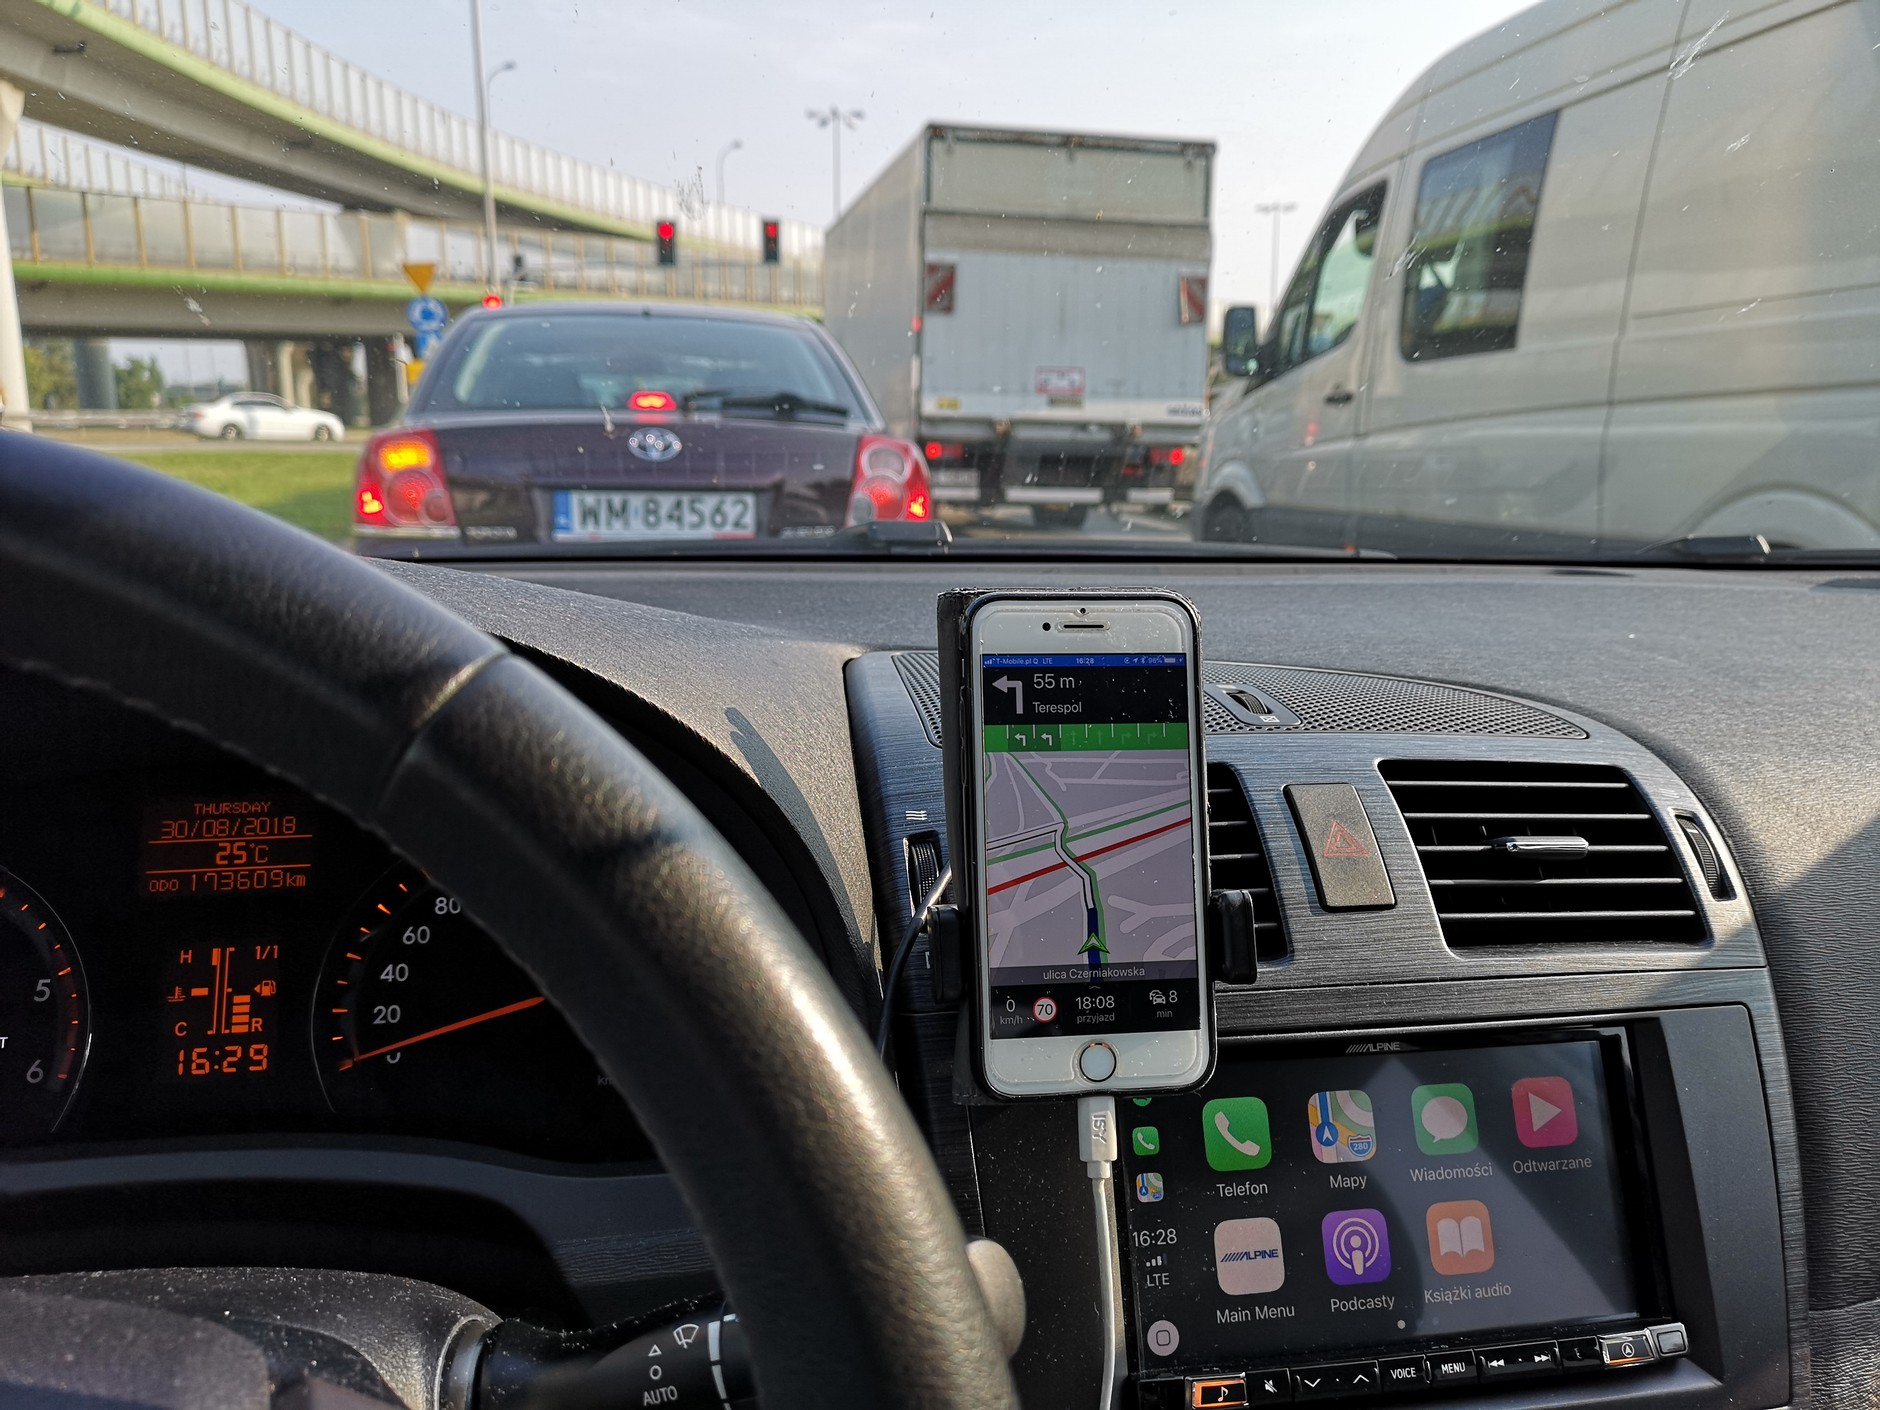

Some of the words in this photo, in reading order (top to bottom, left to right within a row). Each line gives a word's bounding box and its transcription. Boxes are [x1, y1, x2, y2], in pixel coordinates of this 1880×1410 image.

[578, 497, 630, 530] WM
[642, 497, 750, 530] 84562
[996, 657, 1032, 666] T-Mobile.pl
[1043, 657, 1053, 665] LTE
[1076, 657, 1095, 665] 16:28
[1033, 673, 1056, 689] 55
[1060, 677, 1075, 689] m
[1032, 701, 1082, 716] Terespol
[194, 801, 271, 815] THURSDAY
[161, 816, 296, 839] 30/08/2018
[149, 879, 179, 893] ODO
[434, 896, 462, 915] 80
[402, 925, 431, 945] 60
[180, 949, 192, 964] H
[255, 944, 279, 960] 1/1
[380, 963, 409, 983] 40
[1043, 968, 1067, 981] ulica
[1069, 966, 1146, 980] Czerniakowska
[33, 978, 51, 1003] 5
[1168, 990, 1178, 1003] 8
[1006, 999, 1016, 1013] 0
[1036, 1003, 1054, 1016] 70
[1075, 995, 1115, 1010] 18:08
[373, 1004, 401, 1025] 20
[1000, 1015, 1024, 1026] km/h
[1076, 1012, 1116, 1025] przyjazd
[1156, 1009, 1173, 1019] min
[175, 1021, 188, 1037] C
[251, 1017, 263, 1032] R
[1360, 1041, 1401, 1053] ALPINE
[177, 1043, 269, 1076] 16:29
[26, 1059, 44, 1084] 6
[1353, 1142, 1369, 1151] 280
[1409, 1162, 1494, 1183] Wiadomości
[1512, 1156, 1593, 1174] Odtwarzane
[1329, 1174, 1368, 1189] Mapy
[1216, 1181, 1269, 1198] Telefon
[1132, 1228, 1178, 1247] 16:28
[1236, 1248, 1280, 1261] ALPINE
[1146, 1272, 1170, 1287] LTE
[1424, 1284, 1472, 1305] Książki
[1475, 1281, 1512, 1299] audio
[1330, 1294, 1395, 1313] Podcasty
[1216, 1306, 1251, 1324] Main
[1255, 1304, 1295, 1320] Menu
[1390, 1366, 1417, 1380] VOICE
[1440, 1361, 1467, 1375] MENU
[643, 1385, 679, 1407] AUTO
